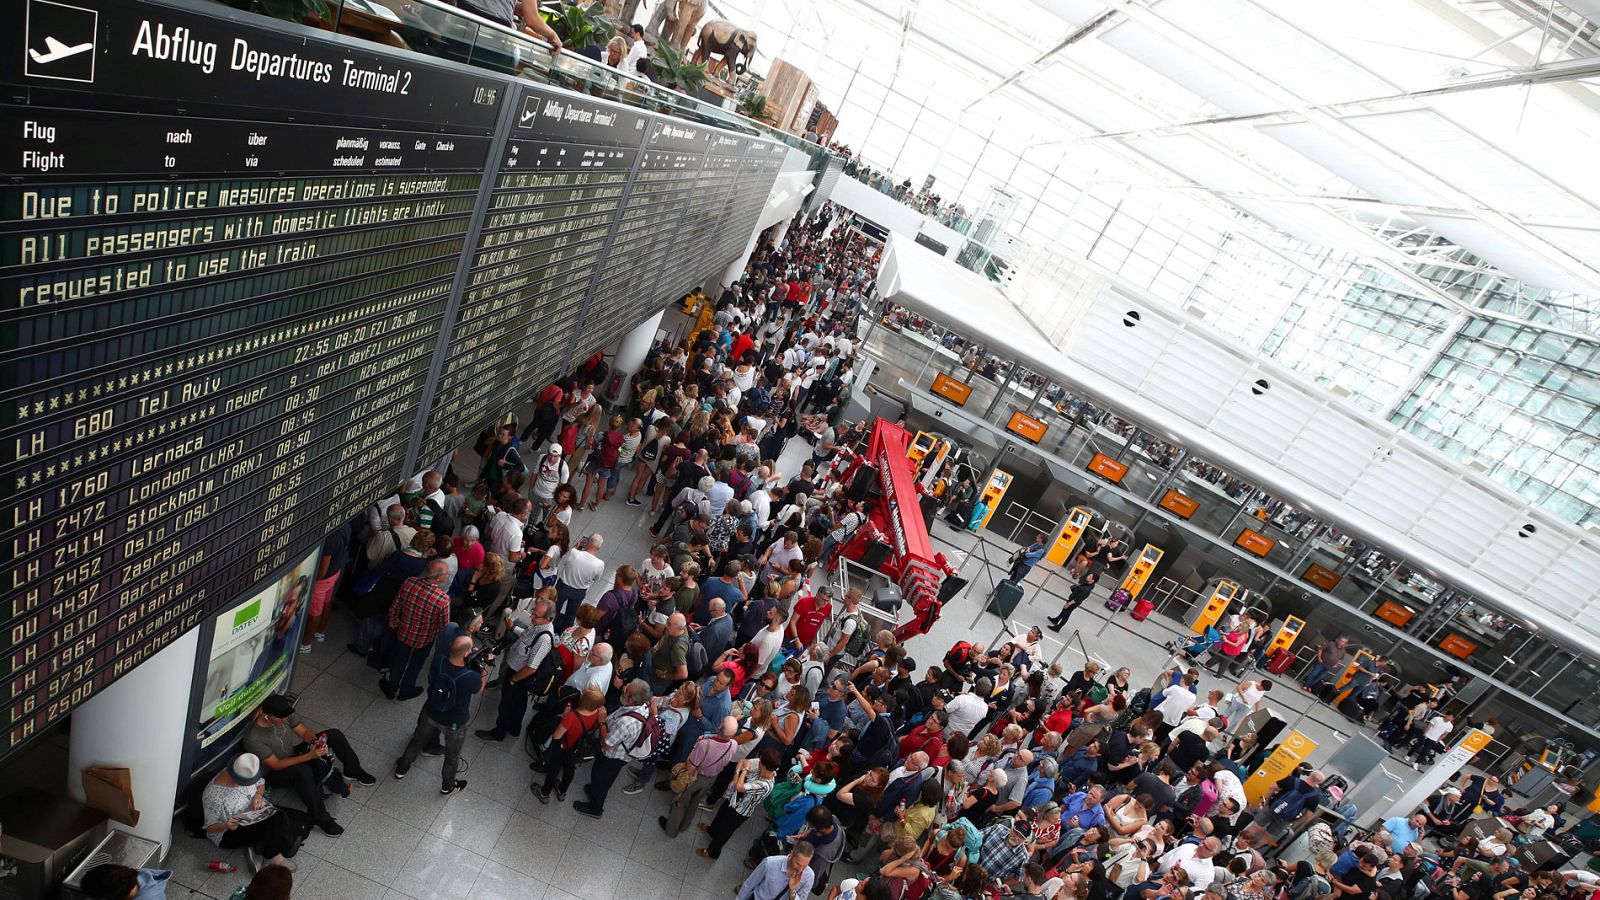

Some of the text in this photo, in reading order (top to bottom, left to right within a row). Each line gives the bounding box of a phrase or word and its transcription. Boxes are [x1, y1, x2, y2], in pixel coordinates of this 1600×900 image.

[132, 20, 412, 95] Abflug Departures Terminal 2
[473, 86, 497, 105] 10:46
[22, 177, 448, 220] Due to police measures operations is suspended.
[23, 121, 56, 143] Flug
[166, 130, 192, 144] nach
[248, 133, 268, 146] über
[336, 137, 369, 150] planmäßig
[379, 140, 401, 150] vorauss.
[415, 140, 426, 150] Gate
[23, 151, 402, 171] Flight to via scheduled estimated
[20, 242, 320, 307] requested to use the train.
[21, 201, 446, 265] All passengers with domestic flights are kindly
[14, 498, 42, 528] LH
[60, 471, 108, 508] 1760
[132, 435, 203, 477] Larnaca
[285, 385, 320, 412] 08:30
[381, 345, 424, 370] cancelled
[16, 431, 45, 460] LH
[75, 409, 114, 440] 680
[139, 391, 169, 417] Tel
[182, 377, 221, 403] Aviv
[295, 338, 329, 364] 22:55
[335, 329, 366, 349] 09:20
[225, 387, 267, 413] neuer
[317, 356, 343, 378] next
[13, 529, 40, 559] LH
[56, 501, 106, 539] 2472
[129, 466, 190, 505] London
[280, 408, 316, 435] 08:45
[376, 366, 410, 391] delayed
[13, 560, 39, 588] LH
[55, 529, 104, 568] 2414
[127, 479, 214, 532] Stockholm
[276, 430, 310, 458] 08:50
[371, 381, 414, 410] cancelled
[13, 589, 38, 617] LH
[53, 557, 101, 596] 2452
[124, 527, 165, 559] Oslo
[272, 451, 306, 480] 08:55
[367, 399, 410, 428] cancelled
[53, 583, 99, 619] 4437
[121, 540, 181, 584] Zagreb
[268, 472, 302, 501] 08:55
[362, 421, 397, 449] delayed
[10, 718, 34, 747] LH
[48, 680, 93, 722] 2500
[114, 609, 203, 678] Manchester
[254, 551, 286, 582] 09:00
[345, 485, 387, 519] cancelled
[11, 670, 36, 698] LH
[52, 633, 96, 673] 1964
[118, 582, 183, 632] Catania
[260, 512, 294, 543] 09:00
[353, 451, 396, 486] cancelled
[11, 695, 35, 723] LG
[50, 657, 94, 698] 9732
[116, 588, 205, 656] Luxembourg
[257, 532, 290, 563] 09:00
[349, 472, 383, 502] delayed
[12, 644, 37, 673] LH
[53, 608, 98, 648] 1810
[120, 549, 204, 609] Barcelona
[264, 493, 298, 523] 09:00
[357, 439, 392, 467] delayed
[232, 616, 259, 636] DATEV
